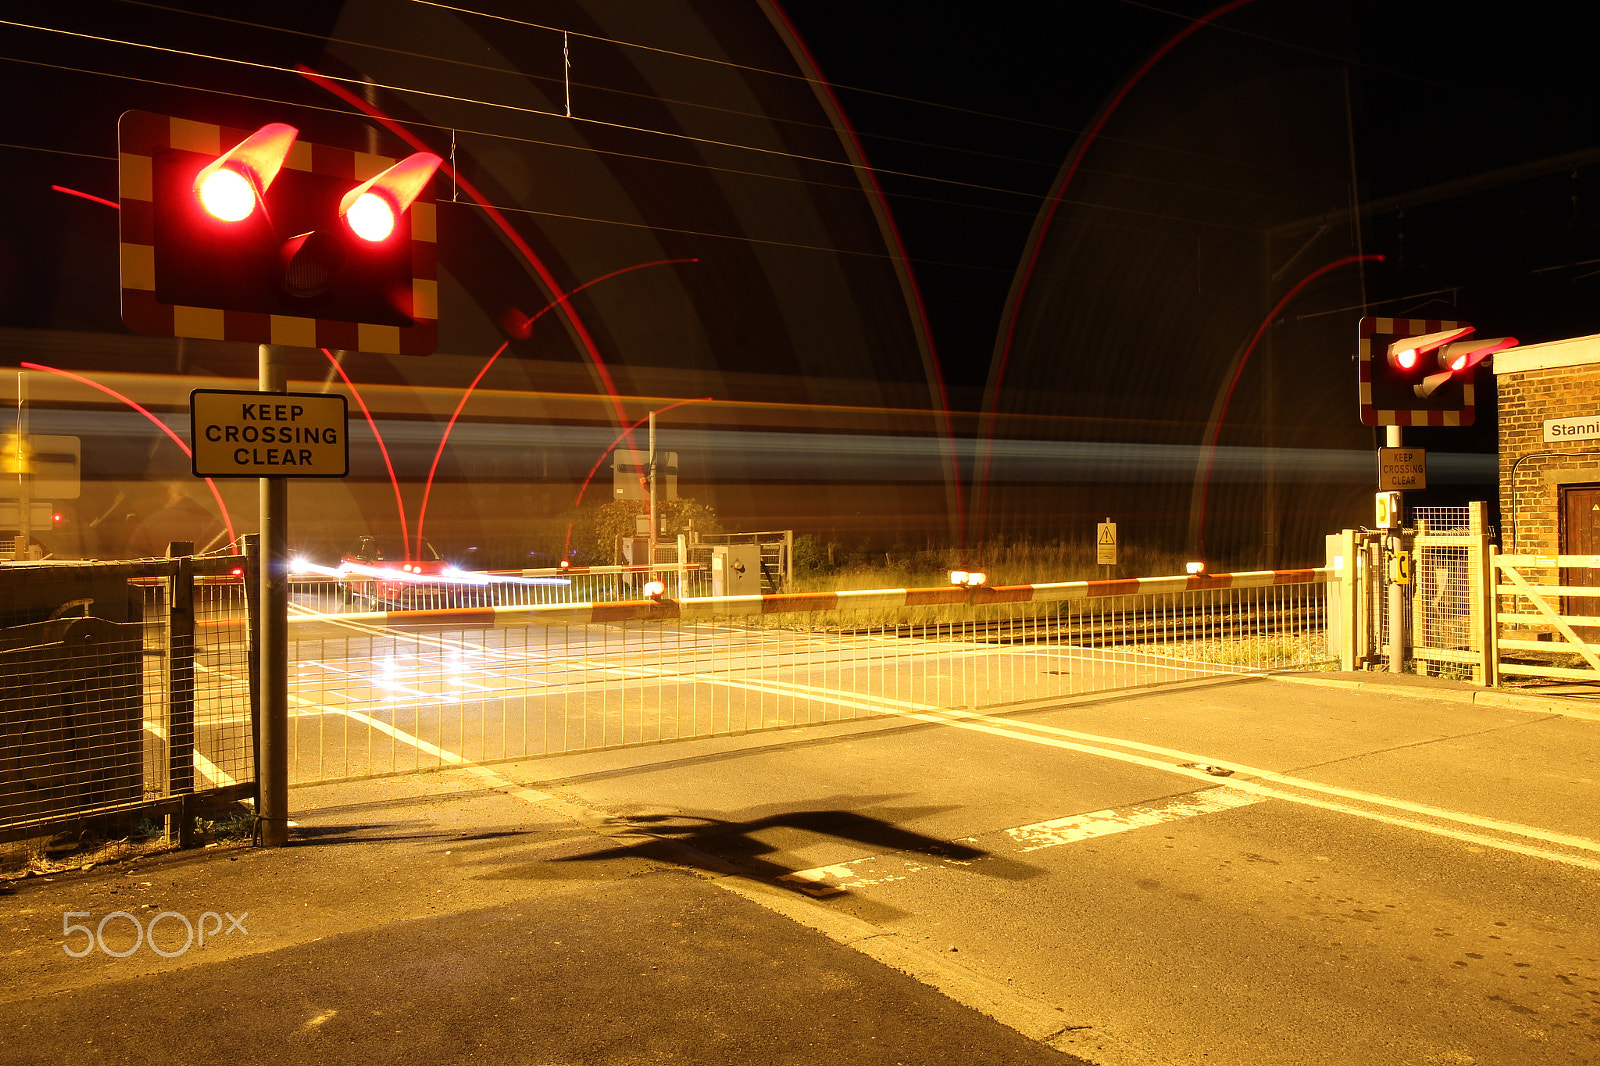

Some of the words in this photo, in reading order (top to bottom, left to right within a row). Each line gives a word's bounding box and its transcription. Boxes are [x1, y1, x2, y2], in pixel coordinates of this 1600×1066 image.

[242, 403, 304, 422] KEEP
[205, 425, 337, 445] CROSSING
[1551, 421, 1600, 436] Stanni
[233, 448, 313, 466] CLEAR
[1394, 453, 1413, 462] KEEP
[1383, 464, 1424, 474] CROSSING
[1391, 476, 1416, 485] CLEAR
